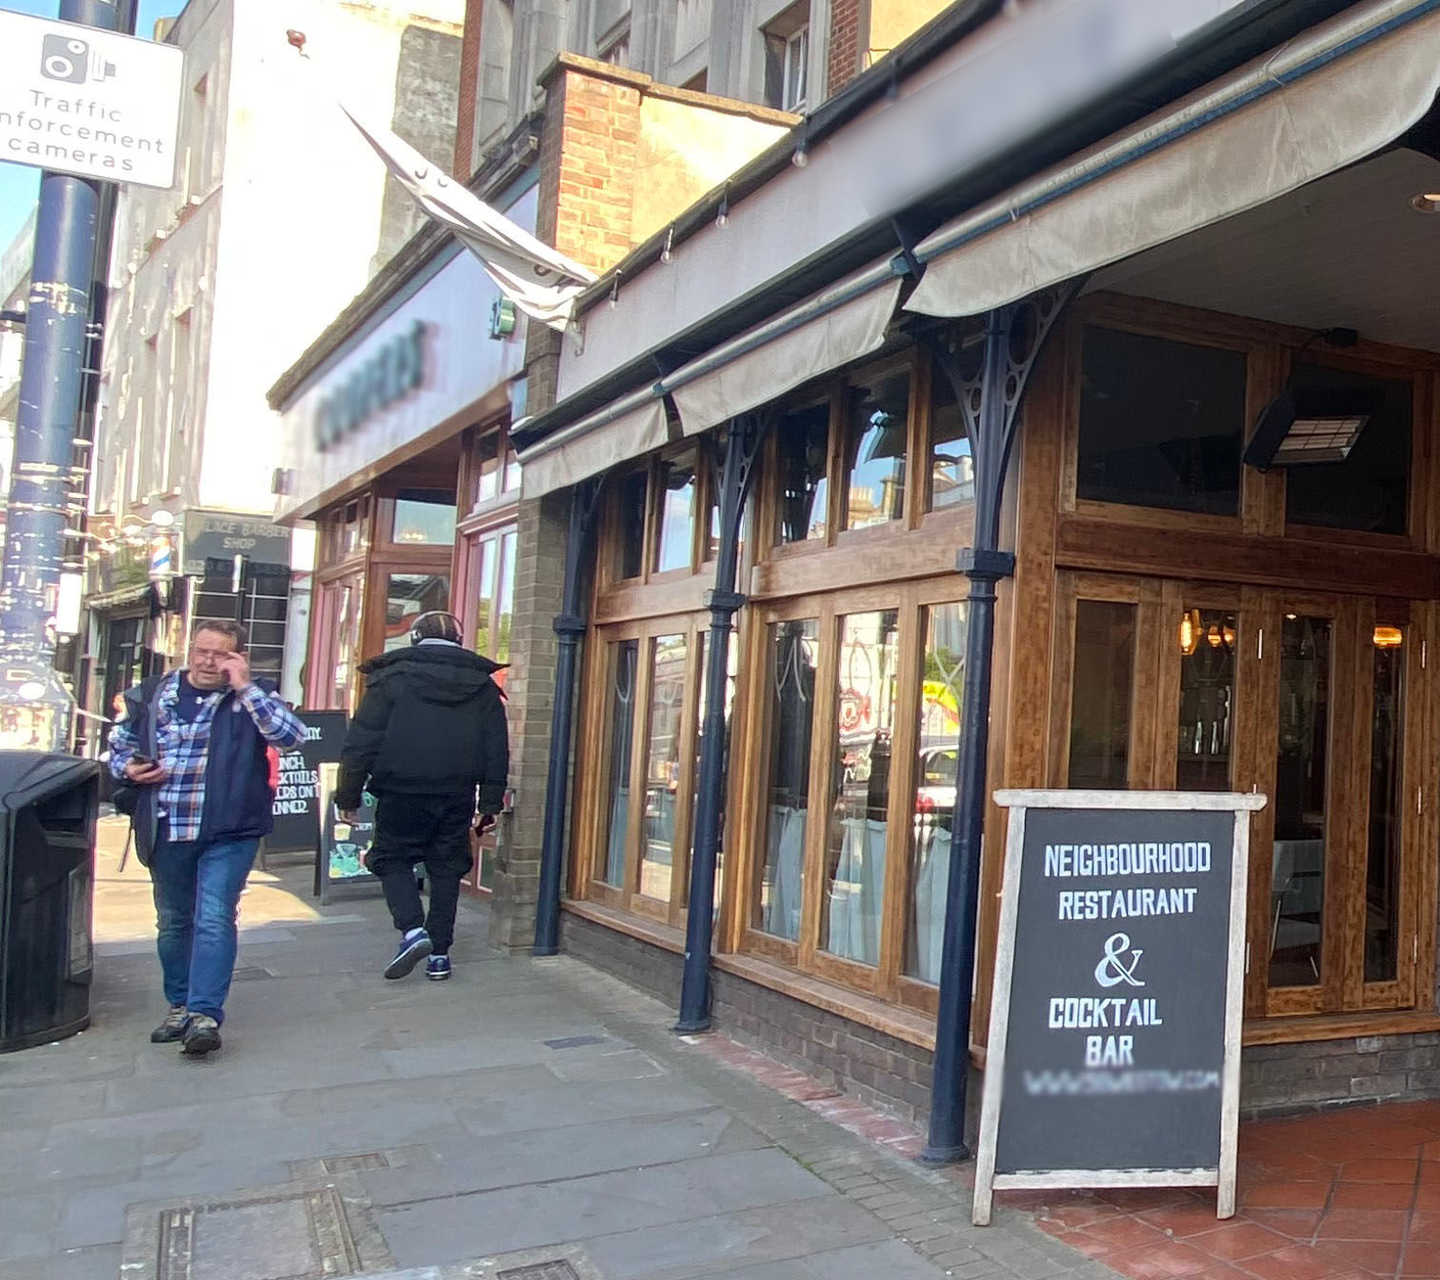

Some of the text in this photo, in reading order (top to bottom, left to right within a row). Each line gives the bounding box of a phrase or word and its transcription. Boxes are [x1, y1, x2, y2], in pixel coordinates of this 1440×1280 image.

[29, 89, 122, 123] Traffic
[0, 111, 164, 154] nforcement
[8, 137, 134, 171] cameras
[222, 536, 256, 550] SHOP
[1044, 842, 1211, 878] NEIGHBOURHOOD
[1058, 887, 1198, 920] RESTAURANT
[1094, 932, 1146, 988] &
[1048, 997, 1163, 1029] COCKTAIL
[1085, 1034, 1134, 1067] BAR
